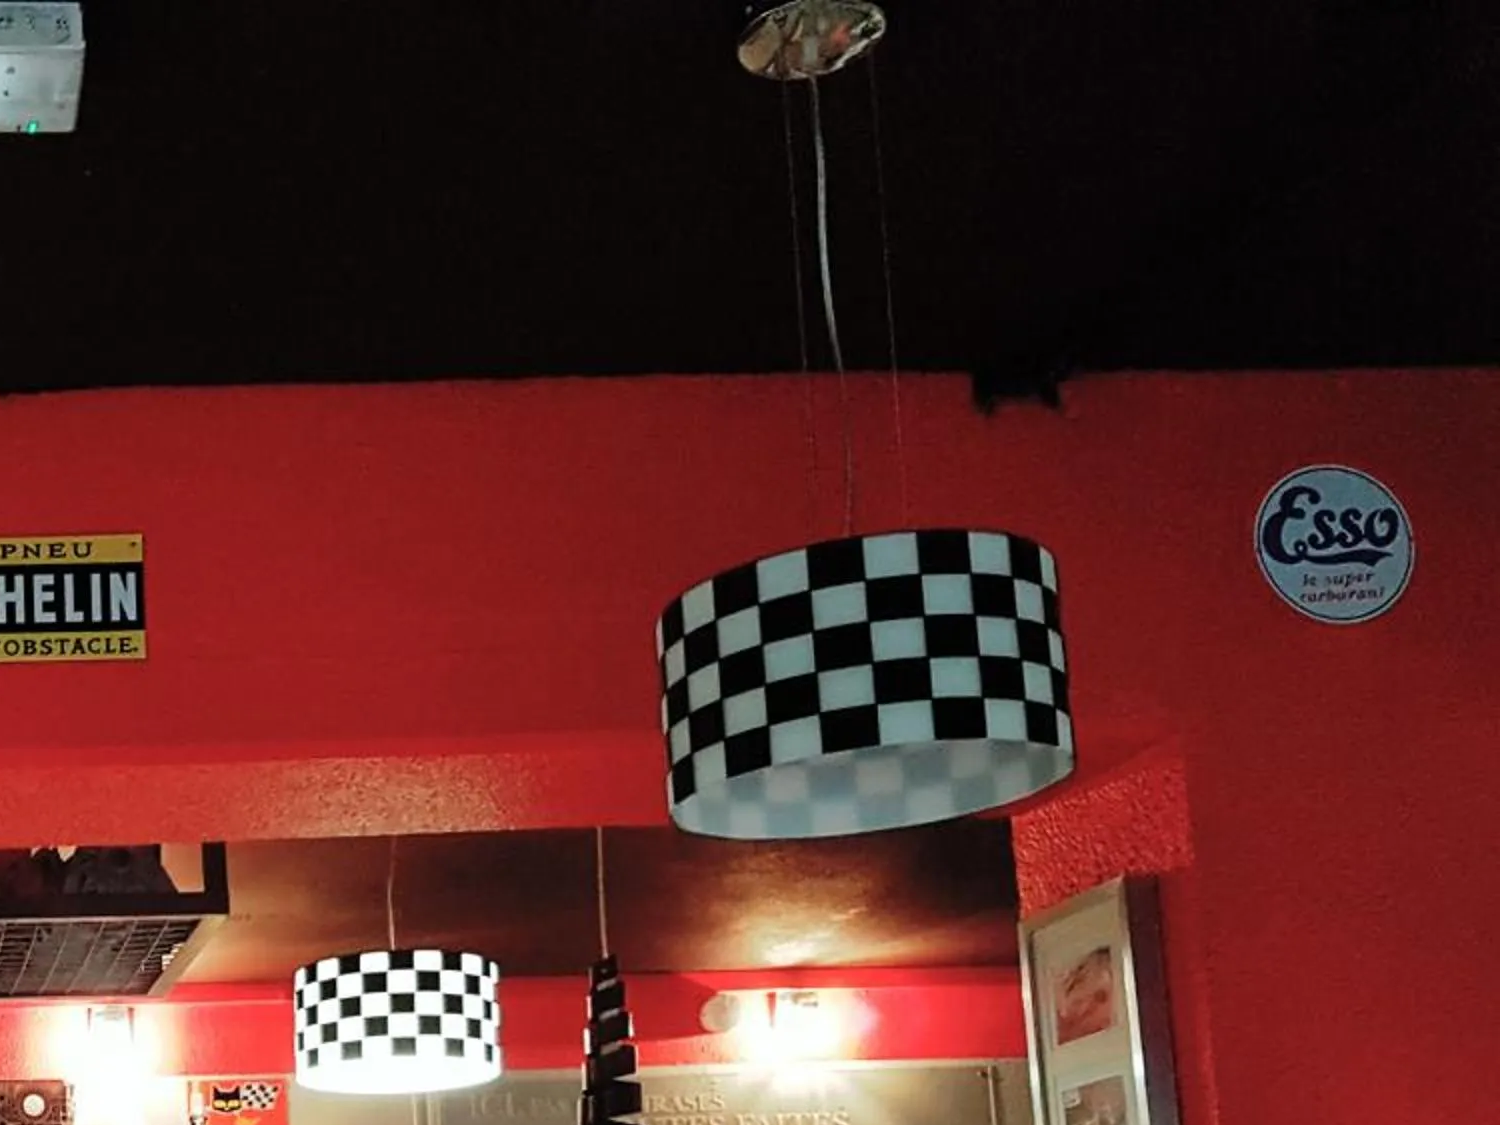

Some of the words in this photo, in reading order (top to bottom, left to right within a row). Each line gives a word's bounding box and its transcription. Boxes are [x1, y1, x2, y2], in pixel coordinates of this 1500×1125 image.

[1263, 485, 1399, 566] Esso
[0, 541, 93, 560] PNEU
[1325, 572, 1375, 587] super
